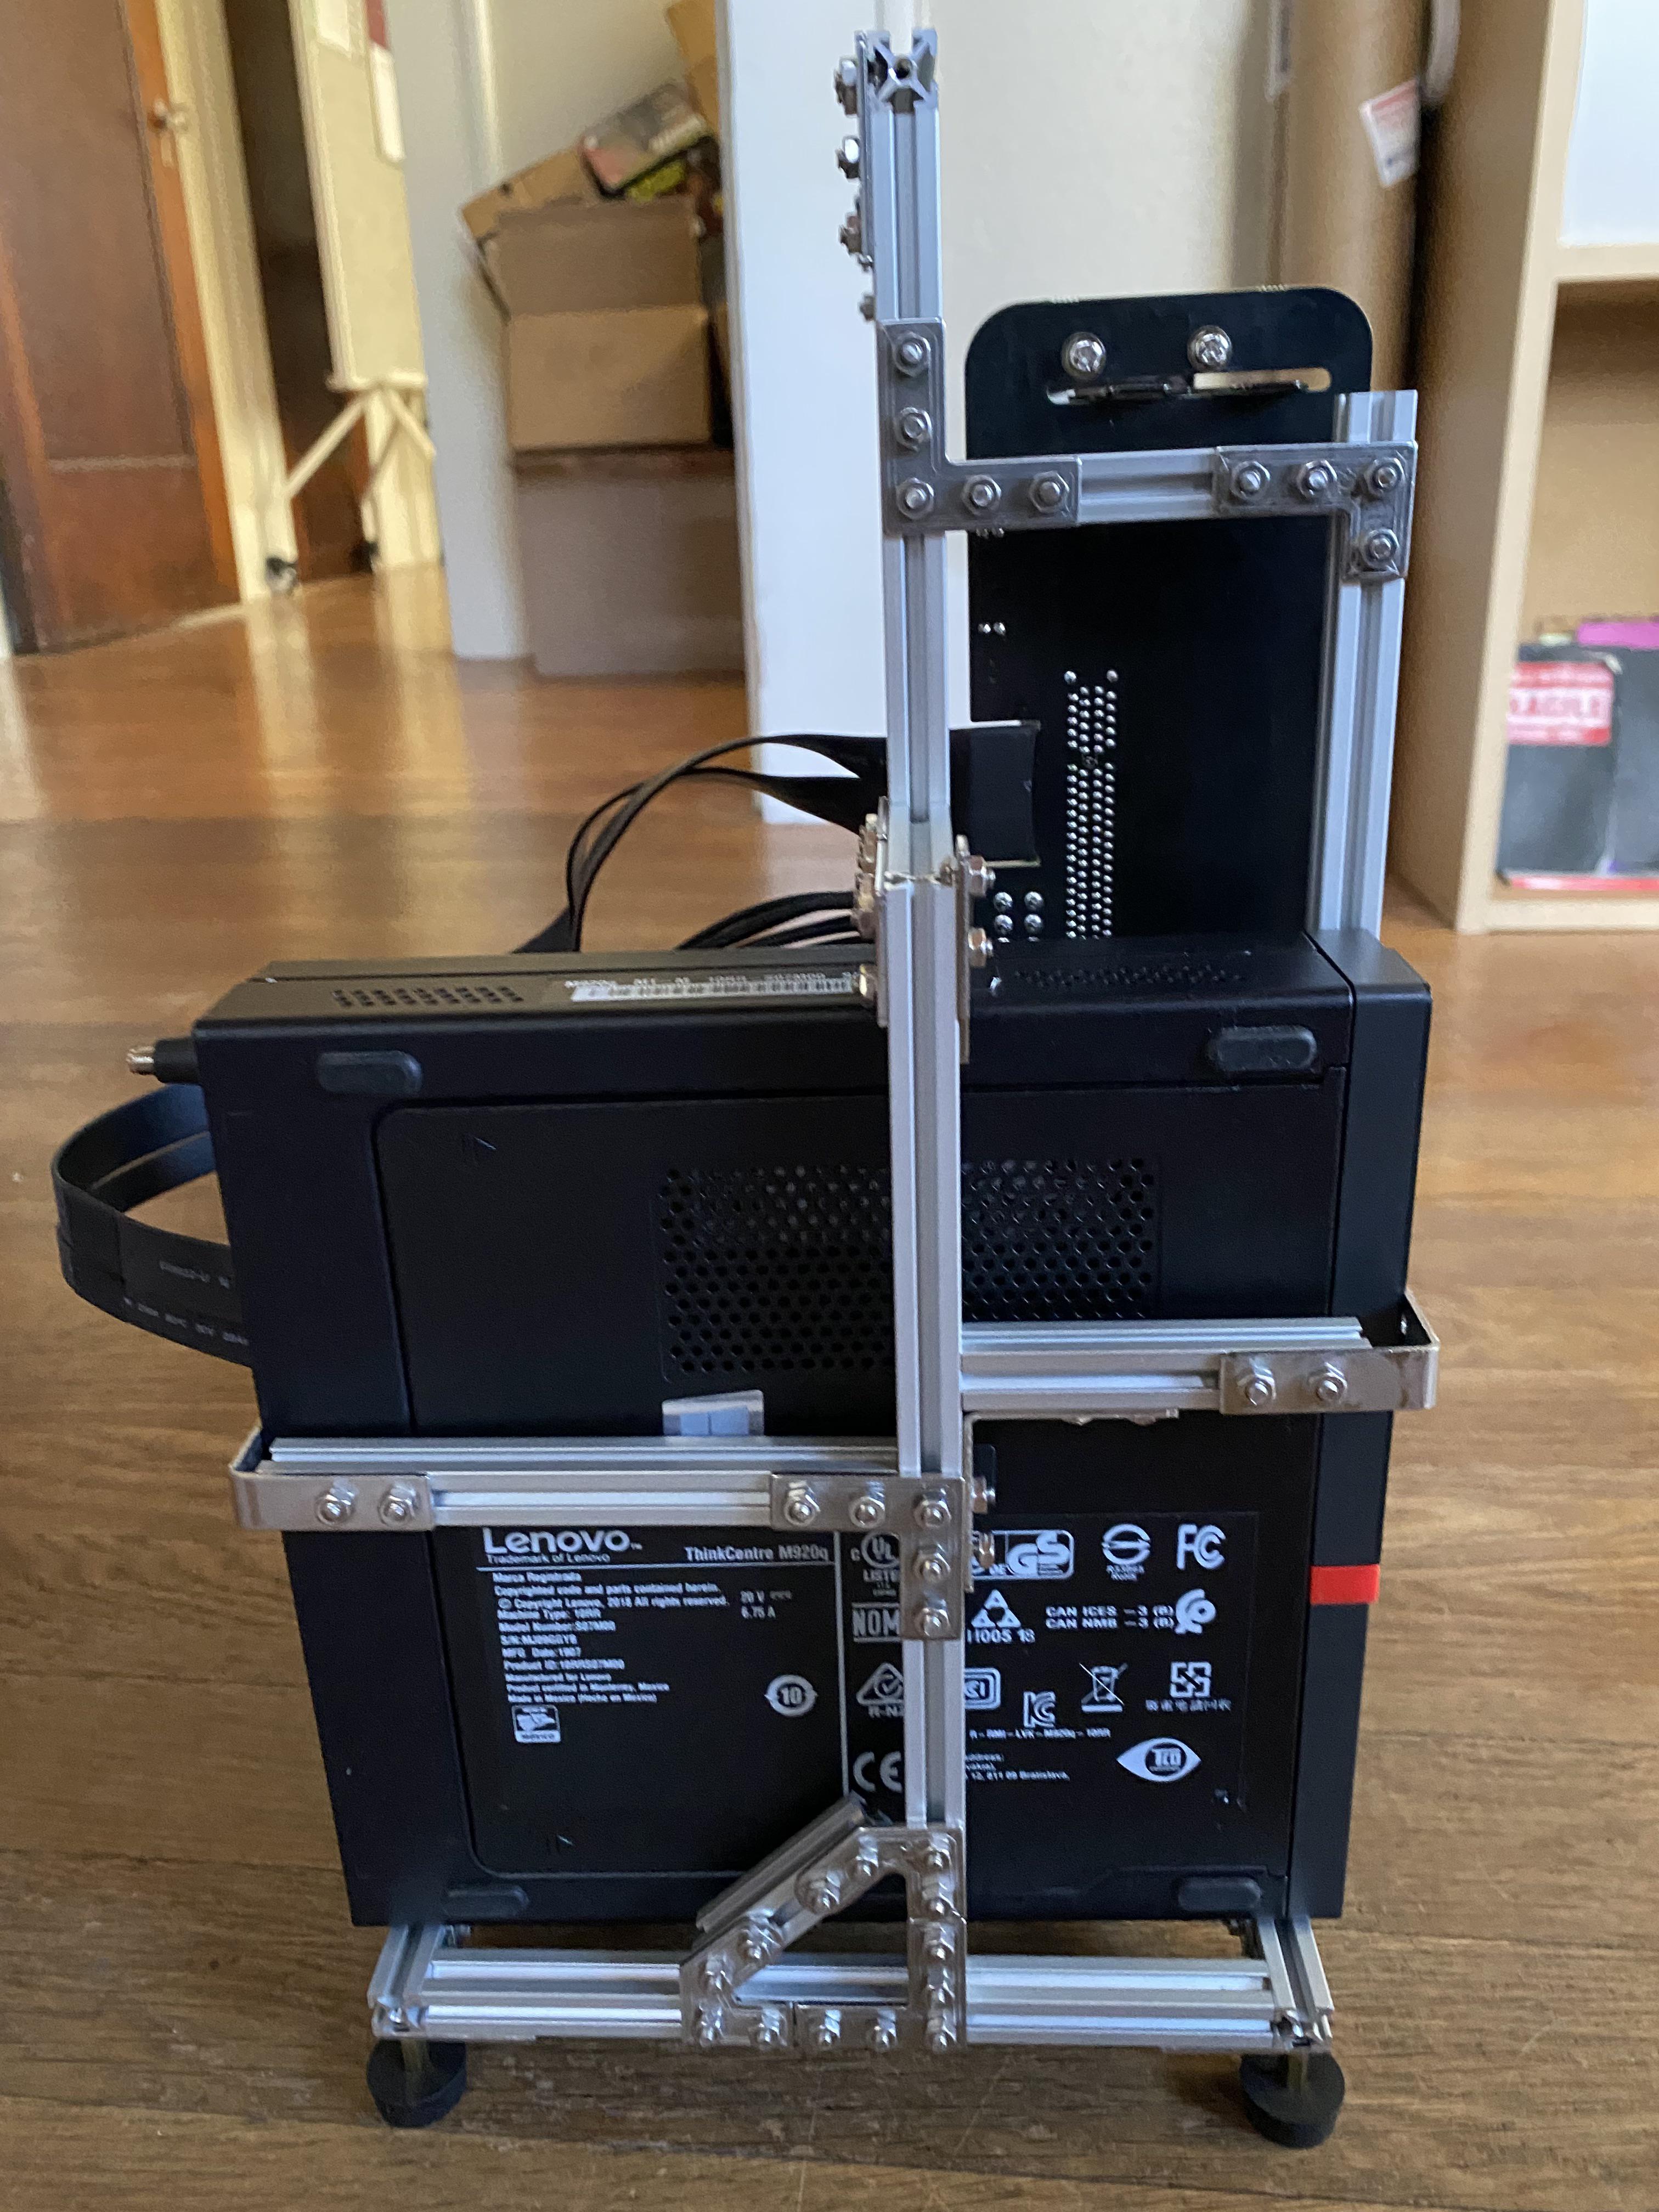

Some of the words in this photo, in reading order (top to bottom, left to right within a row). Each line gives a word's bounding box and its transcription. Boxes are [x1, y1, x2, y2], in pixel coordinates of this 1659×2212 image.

[482, 1527, 630, 1554] Lenovo
[487, 1553, 550, 1564] Trademark
[552, 1552, 565, 1563] of
[566, 1551, 611, 1563] Lenovo
[684, 1546, 774, 1562] ThinkCentre
[778, 1544, 829, 1562] M920q
[1046, 1606, 1077, 1618] CAN
[852, 1608, 900, 1637] NOM
[1046, 1618, 1077, 1629] CAN
[781, 1687, 802, 1705] 10
[853, 1751, 903, 1793] CE
